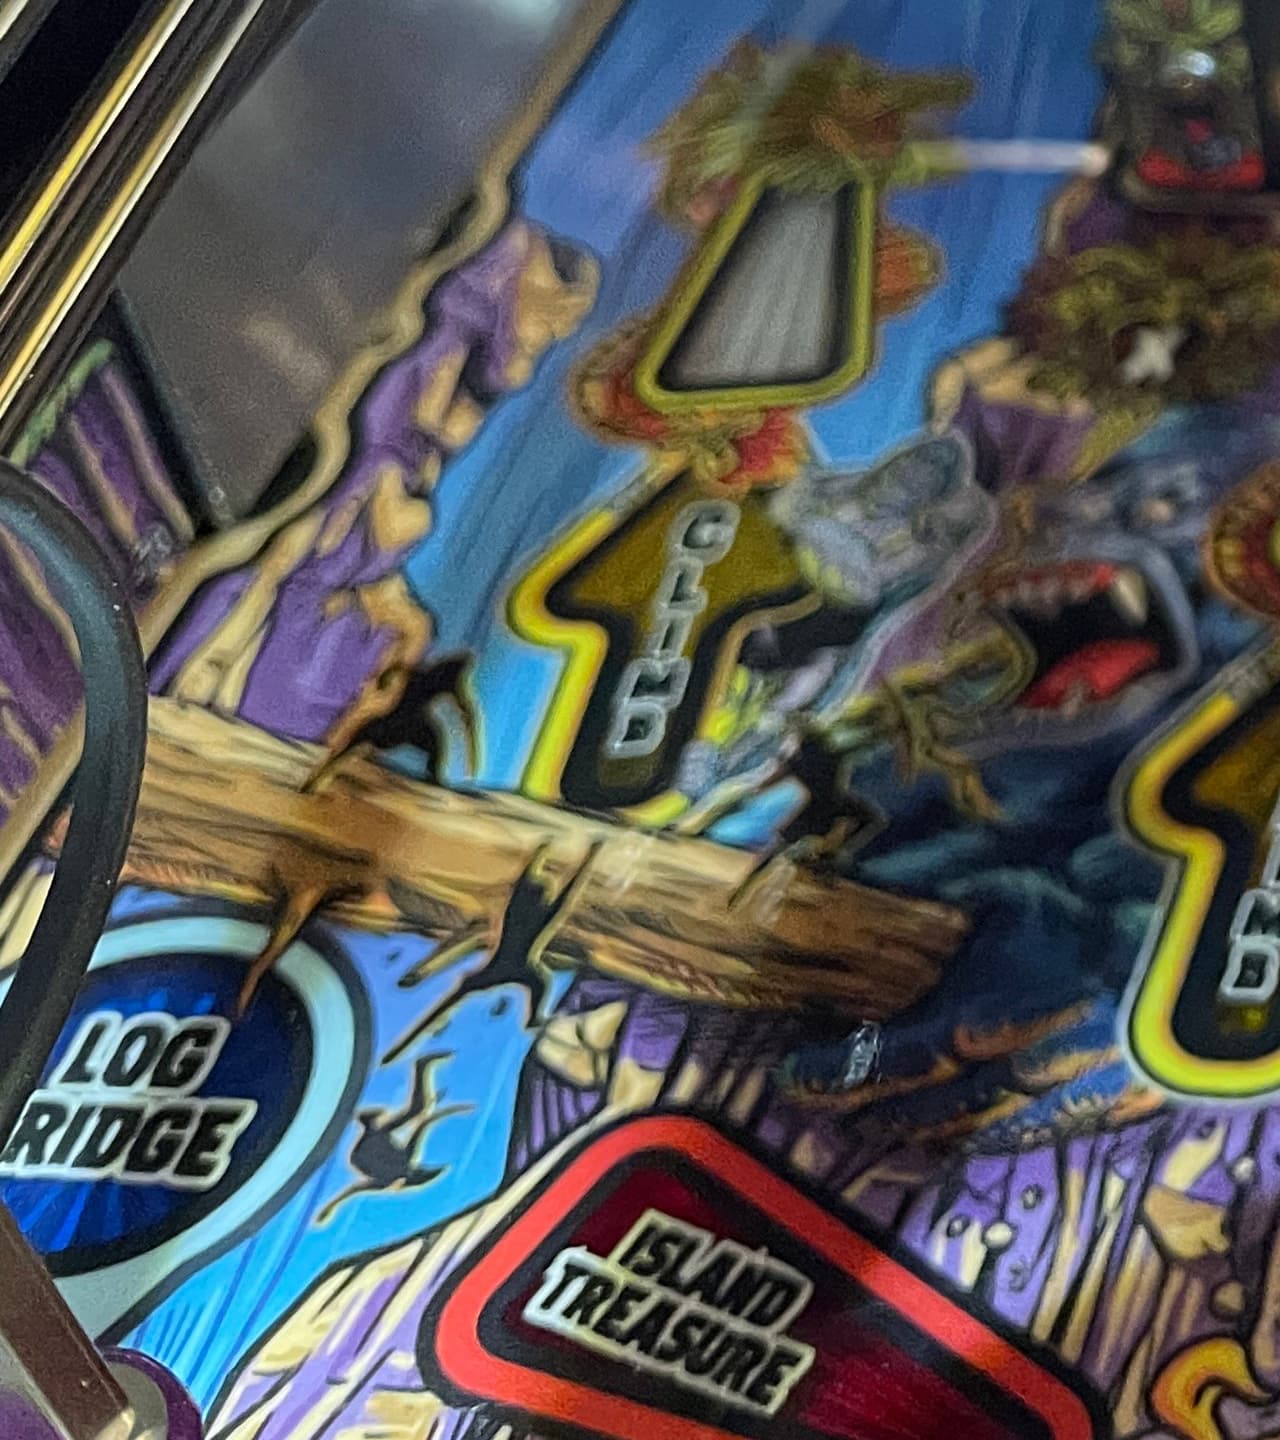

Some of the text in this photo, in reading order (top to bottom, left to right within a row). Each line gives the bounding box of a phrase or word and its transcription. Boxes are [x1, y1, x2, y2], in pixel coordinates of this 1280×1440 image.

[52, 1015, 226, 1092] LOG
[0, 1095, 255, 1180] RIDGE
[616, 1218, 810, 1330] ISLAND
[528, 1255, 810, 1410] TREASURE
